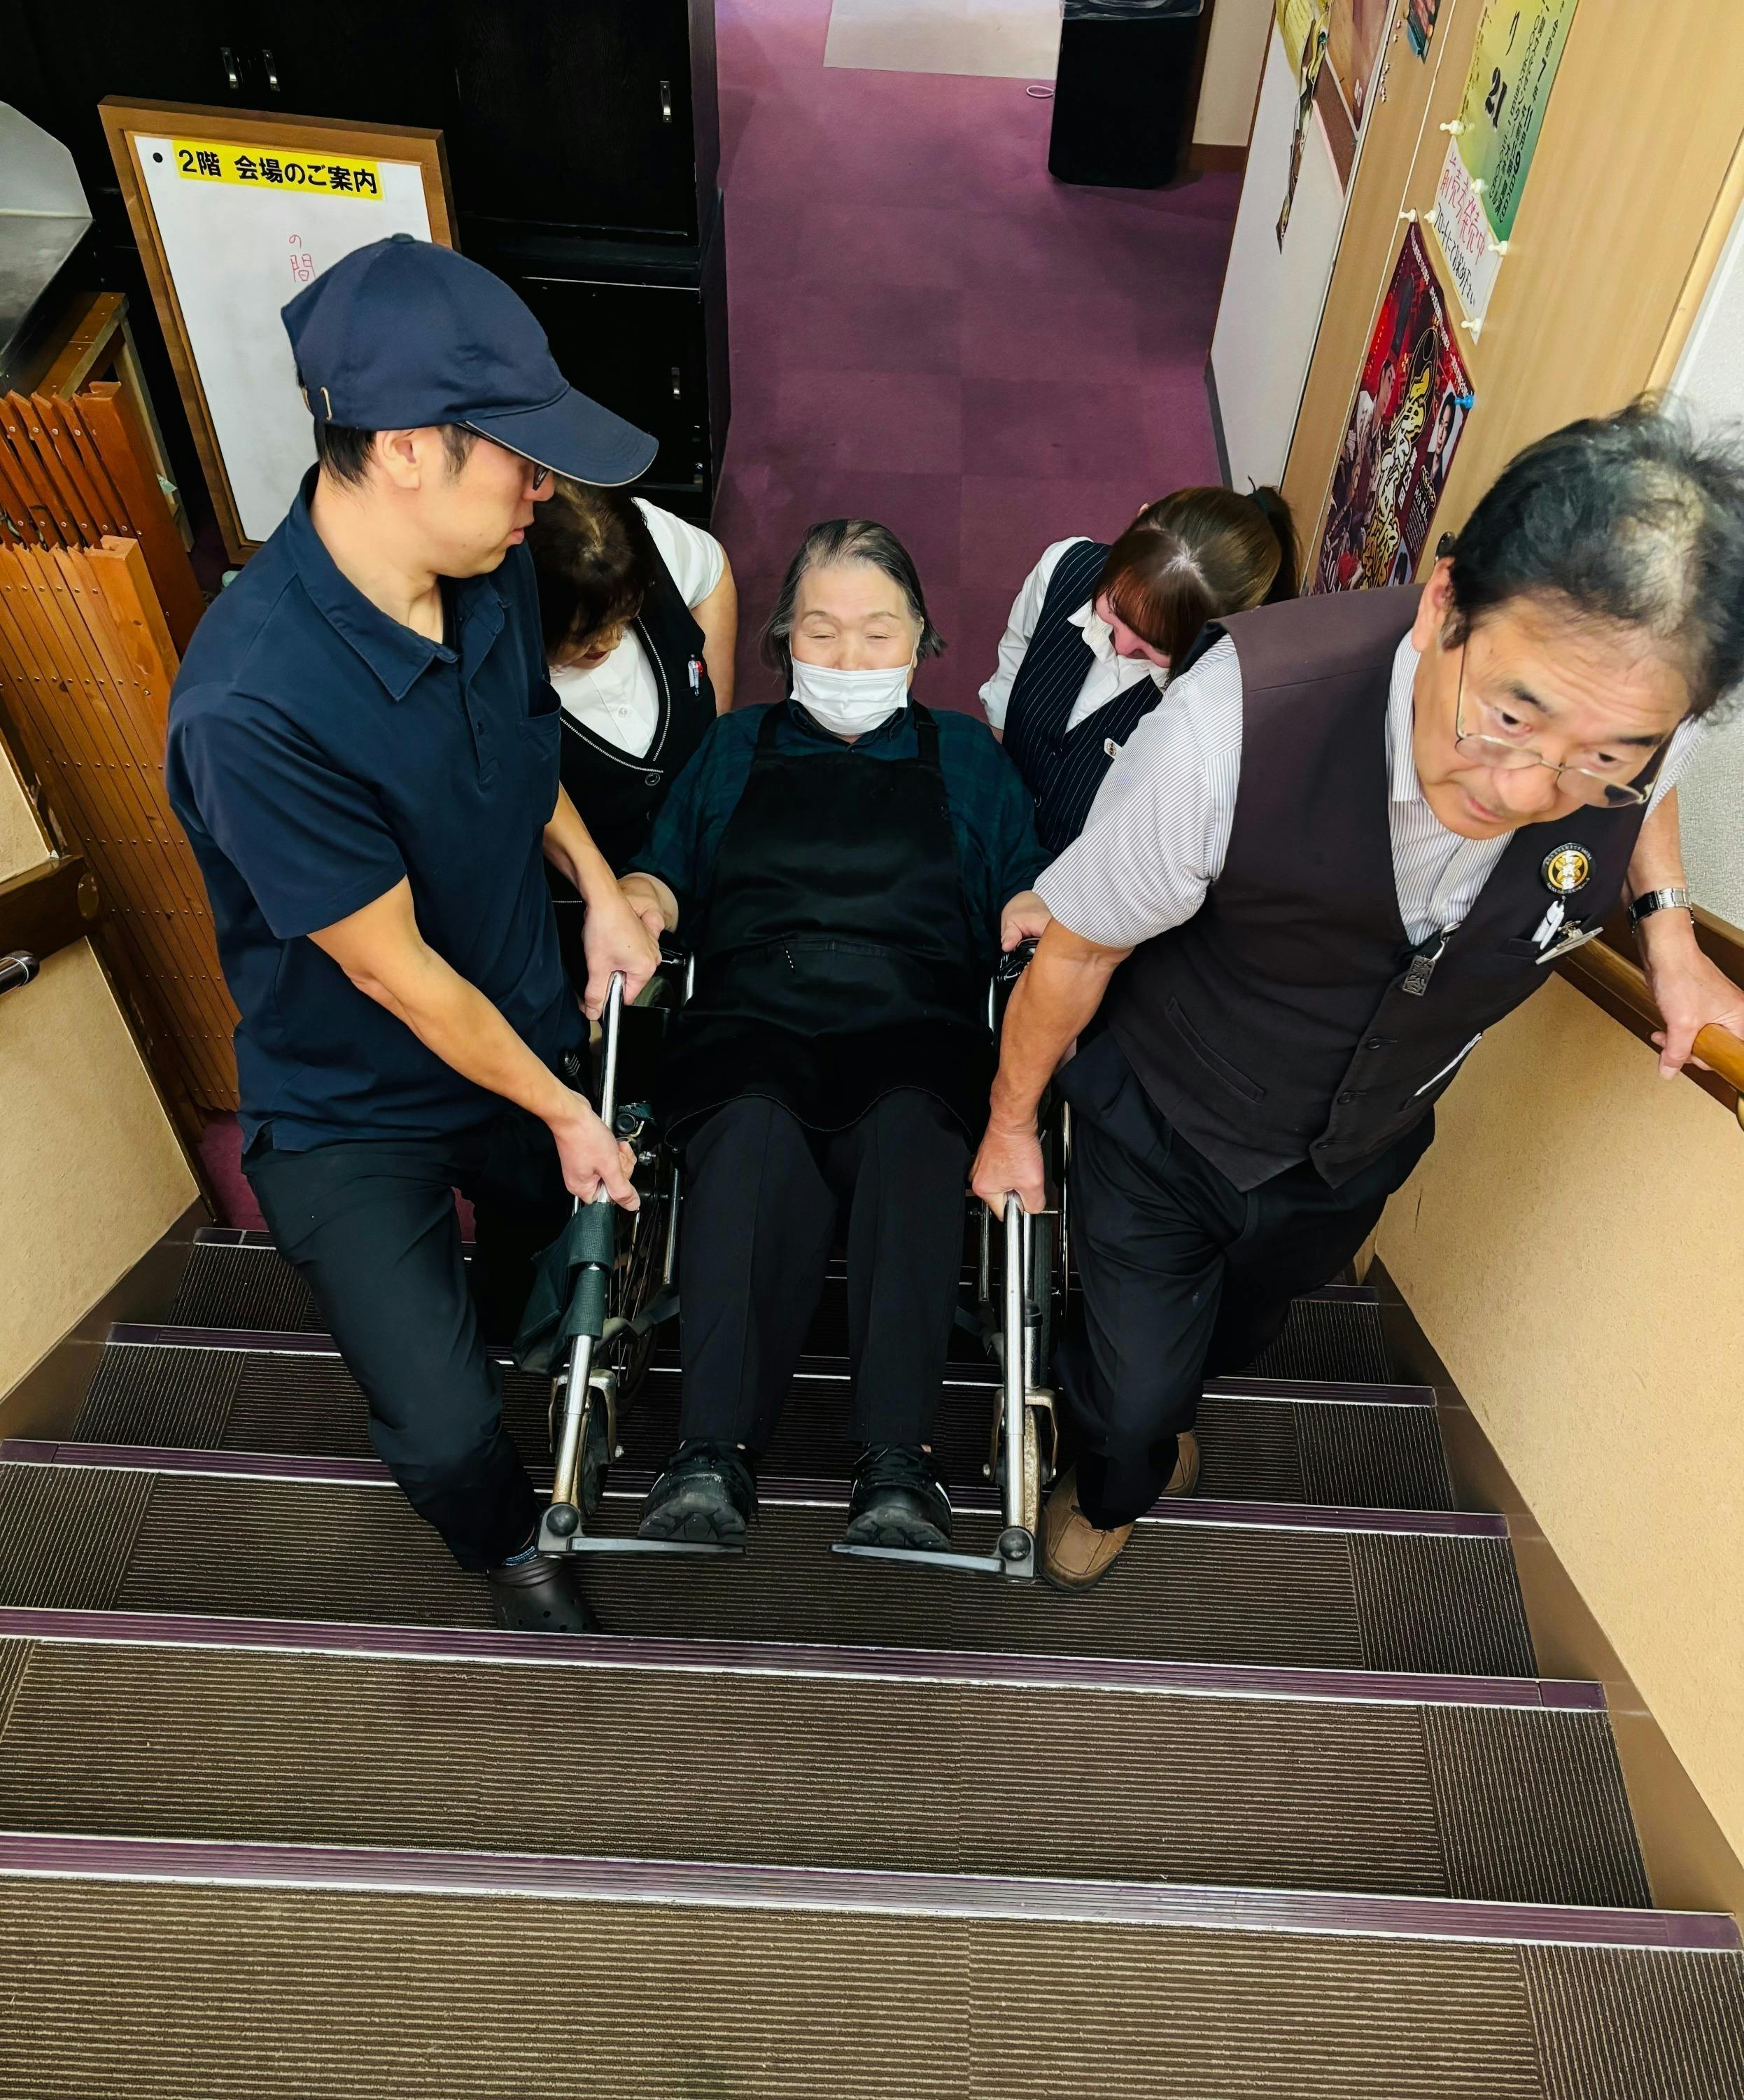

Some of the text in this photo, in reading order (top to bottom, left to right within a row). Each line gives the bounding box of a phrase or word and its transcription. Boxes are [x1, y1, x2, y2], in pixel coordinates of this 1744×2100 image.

[178, 149, 378, 194] 2階 会場のご案内
